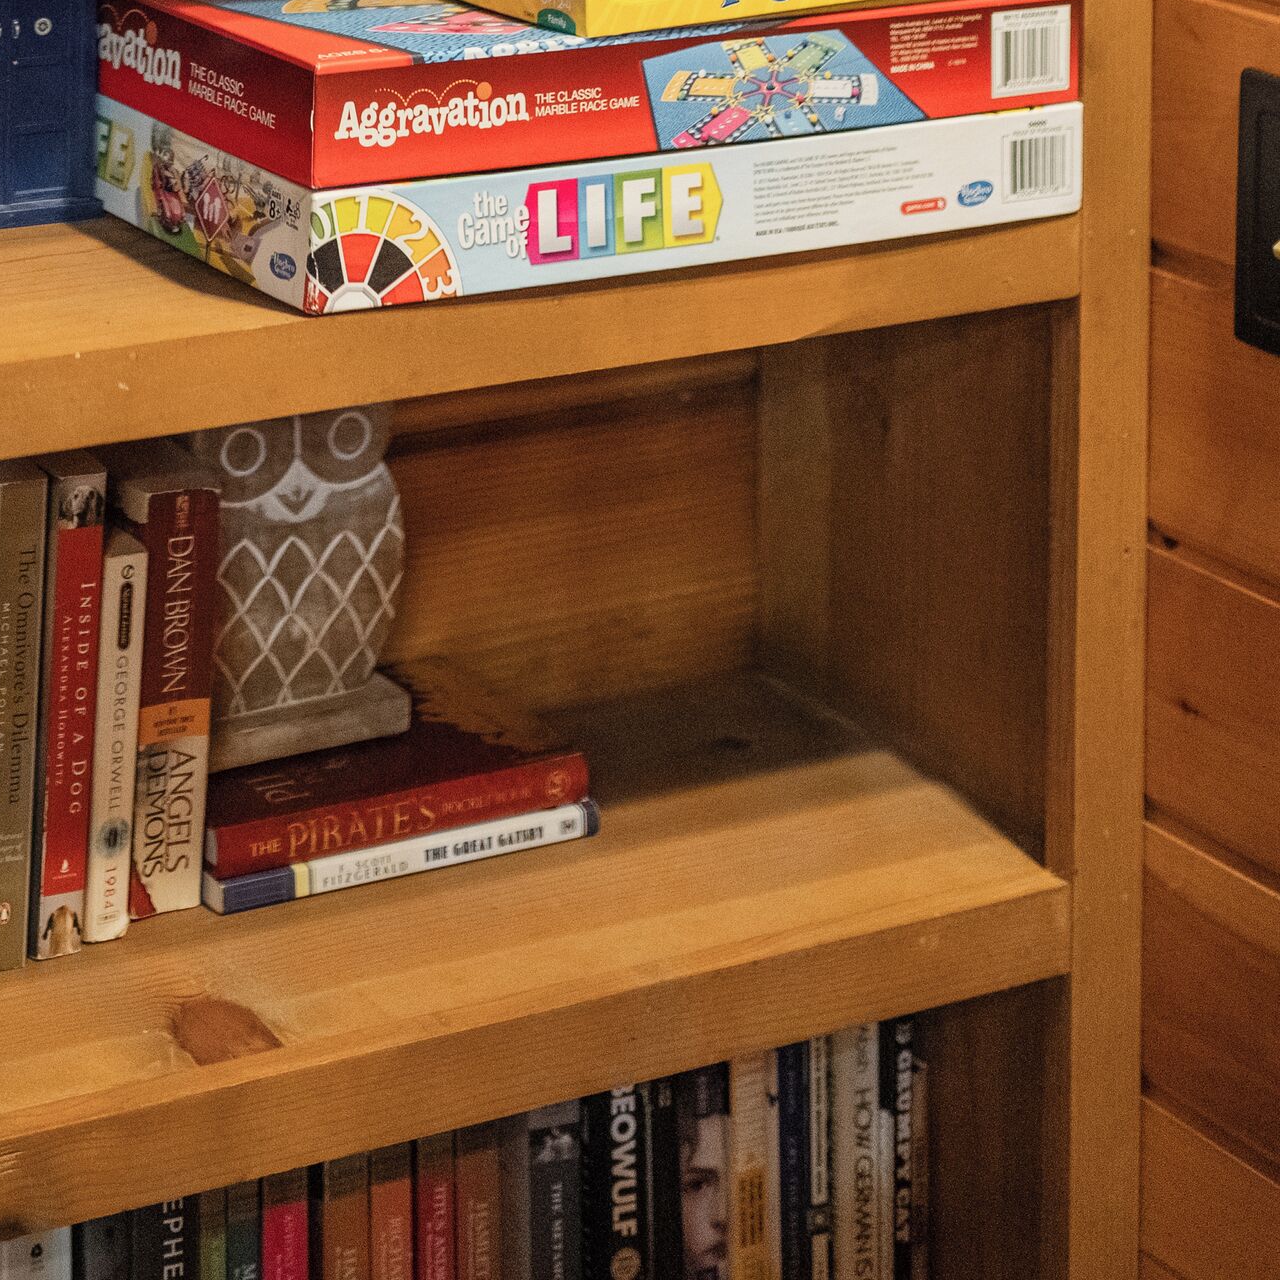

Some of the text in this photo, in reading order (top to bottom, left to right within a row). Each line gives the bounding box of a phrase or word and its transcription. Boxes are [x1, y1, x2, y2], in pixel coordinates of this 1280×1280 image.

[187, 80, 276, 130] MARBLE RACE GAME
[189, 62, 245, 97] THE CLASSIC
[534, 87, 602, 105] THE CLASSIC
[534, 95, 640, 118] MARBLE RACE GAME
[333, 88, 531, 148] Aggravation
[456, 203, 530, 251] Game
[472, 191, 508, 218] the
[536, 171, 704, 255] LIFE
[505, 230, 528, 260] of
[17, 546, 36, 575] The
[165, 535, 195, 593] DAN
[12, 591, 34, 704] Omnivore's
[160, 599, 191, 695] BROWN
[54, 615, 73, 787] ALEXANDRA HOROWITZ
[68, 581, 97, 816] INSIDE OF A DOG
[111, 655, 129, 733] GEORGE
[7, 711, 30, 806] Dilemma
[107, 740, 126, 813] ORWELL
[142, 749, 171, 879] DEMONS
[164, 749, 197, 875] ANGELS
[249, 838, 281, 858] THE
[286, 796, 437, 858] PIRATE'S
[423, 825, 544, 863] THE GREAT GATSBY
[103, 866, 118, 910] 1984
